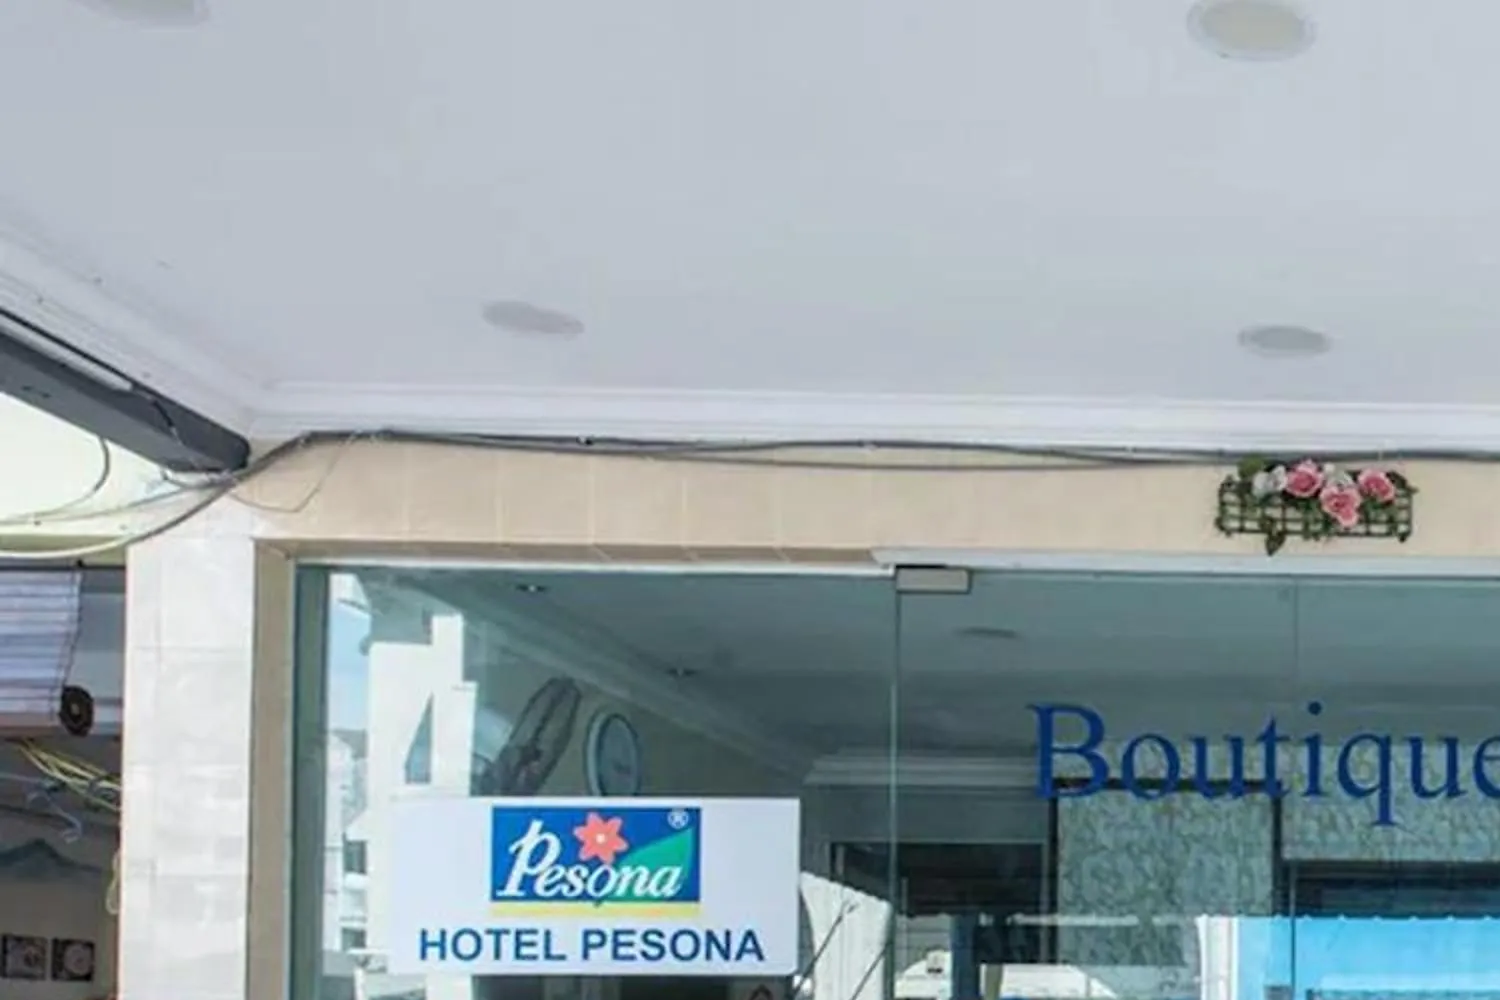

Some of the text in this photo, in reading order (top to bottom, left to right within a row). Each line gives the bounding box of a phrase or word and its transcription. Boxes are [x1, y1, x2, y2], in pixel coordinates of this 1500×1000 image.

[496, 819, 685, 899] Pesona
[419, 927, 766, 962] HOTEL PESONA
